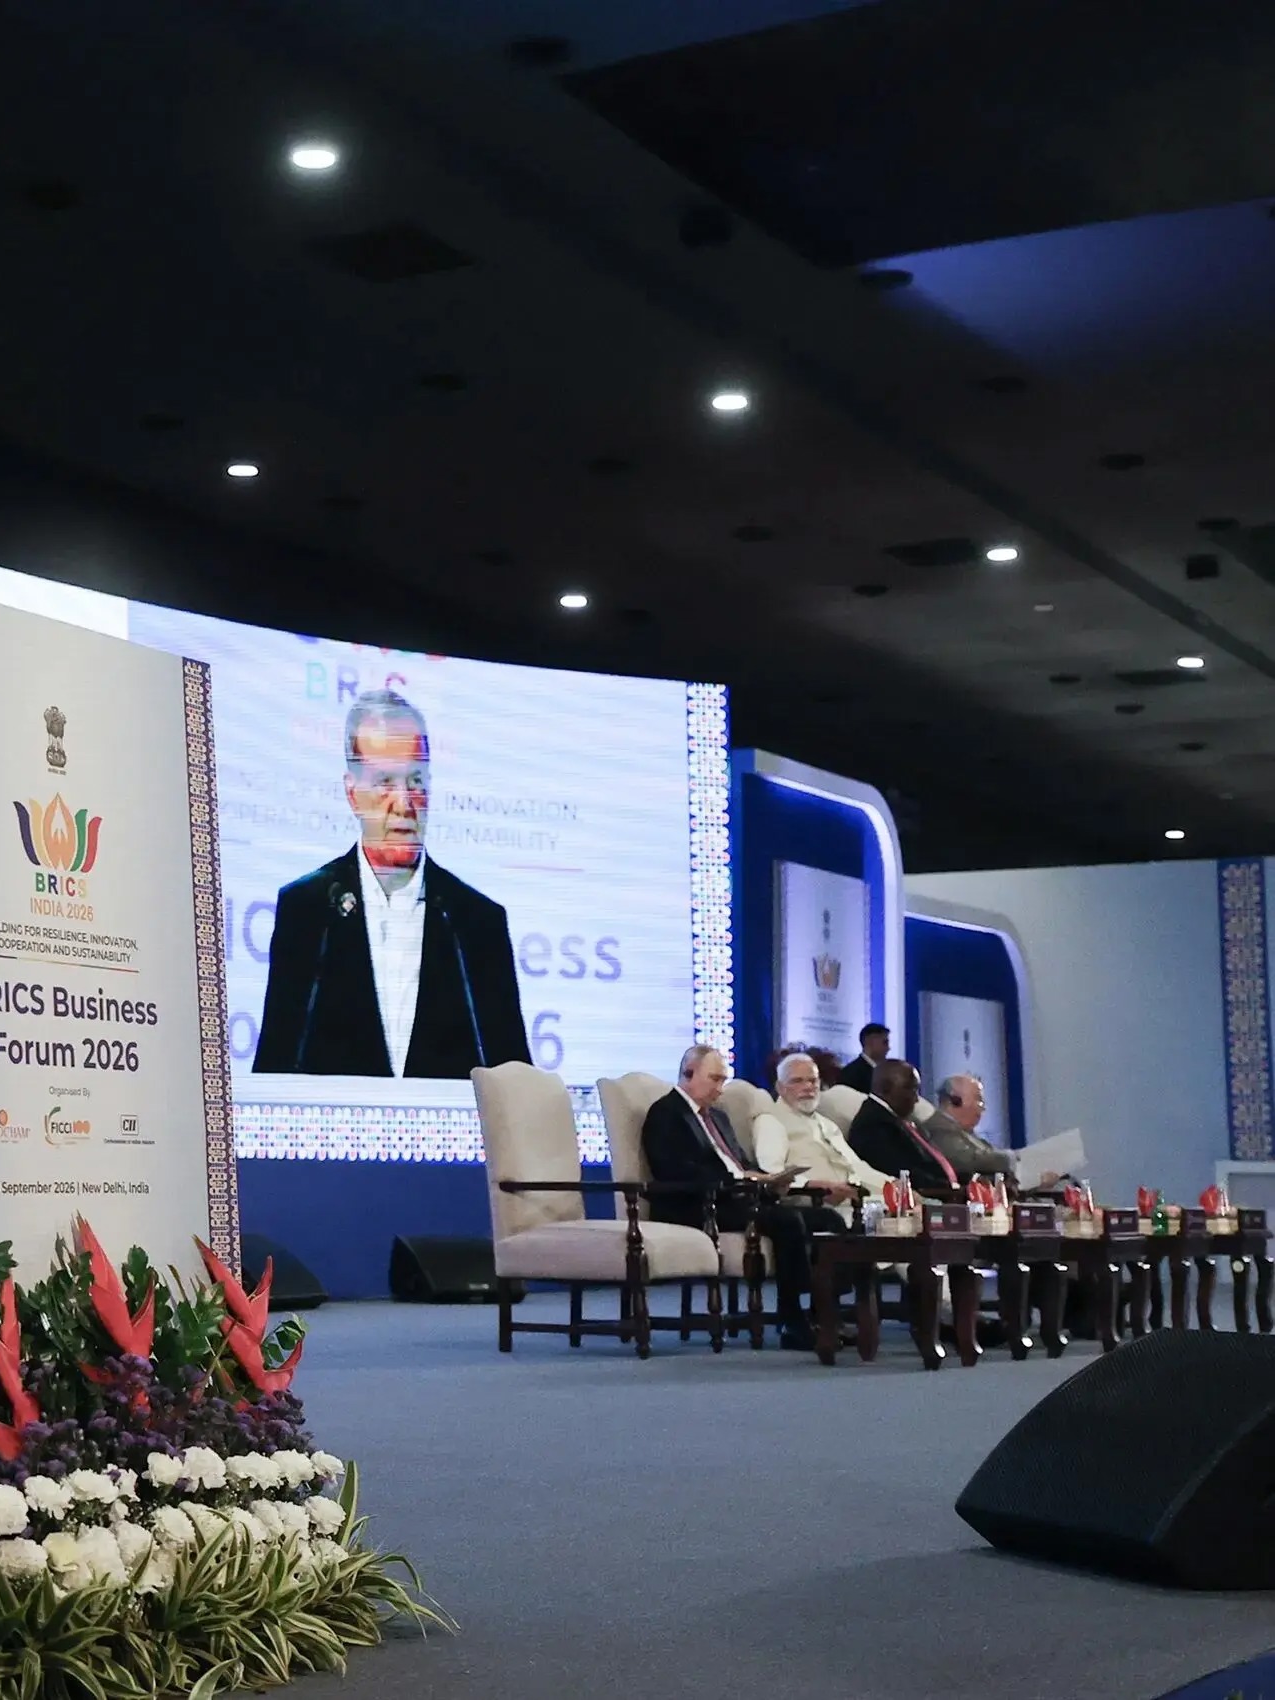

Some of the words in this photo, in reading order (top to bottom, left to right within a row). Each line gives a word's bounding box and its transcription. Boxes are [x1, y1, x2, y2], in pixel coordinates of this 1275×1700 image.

[35, 872, 87, 897] BRICS
[30, 897, 64, 919] INDIA
[25, 925, 41, 937] FOR
[42, 927, 89, 944] RESILIENCE,
[90, 934, 139, 951] INNOVATION,
[52, 945, 71, 956] AND
[72, 946, 131, 964] SUSTAINABILITY
[53, 986, 158, 1026] Business
[82, 1037, 140, 1073] 2026
[49, 1085, 82, 1097] Organised
[83, 1087, 91, 1099] By
[51, 1121, 72, 1134] FICCI
[122, 1119, 136, 1132] CII
[1, 1181, 52, 1196] September
[54, 1182, 76, 1195] 2026
[82, 1183, 102, 1195] New
[103, 1182, 127, 1196] Delhi,
[128, 1182, 150, 1195] India
